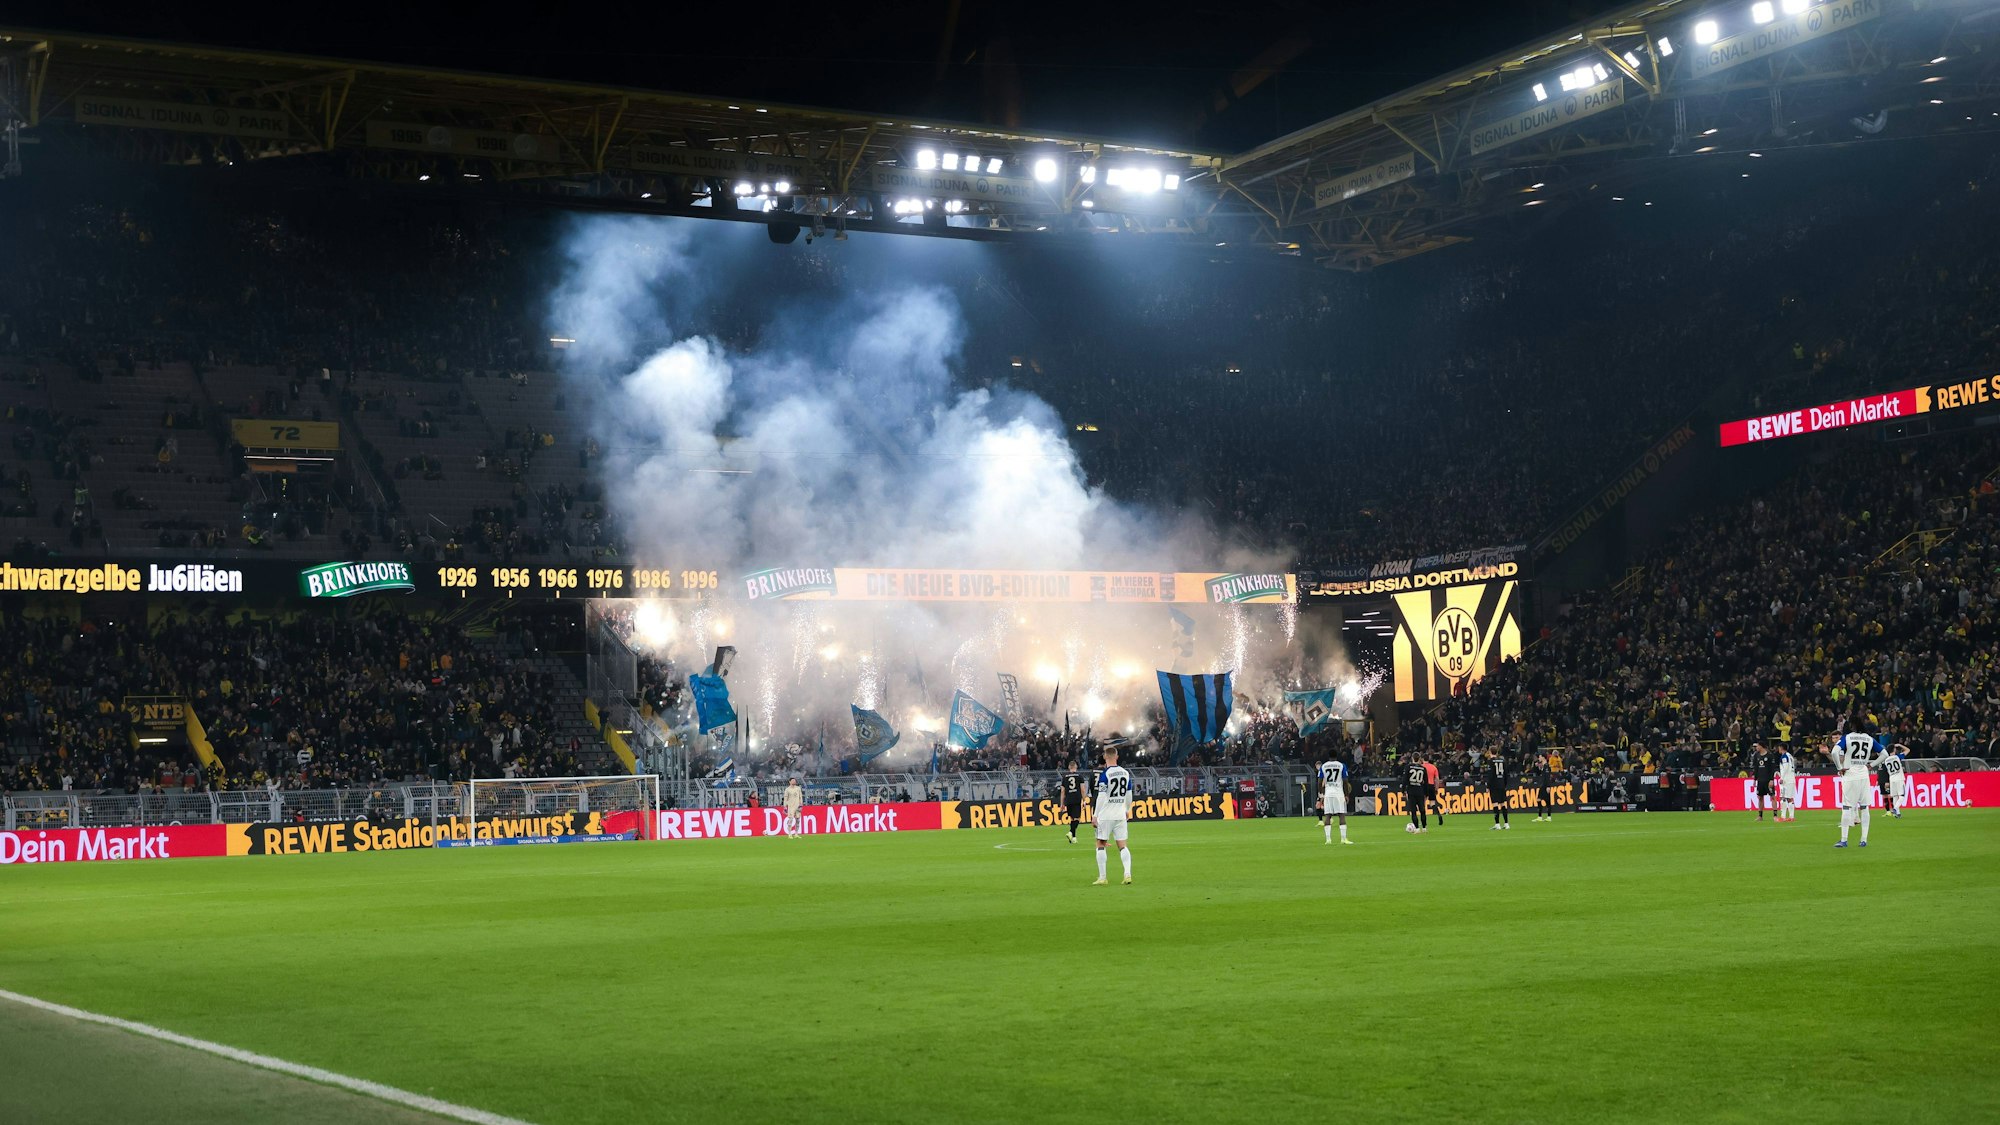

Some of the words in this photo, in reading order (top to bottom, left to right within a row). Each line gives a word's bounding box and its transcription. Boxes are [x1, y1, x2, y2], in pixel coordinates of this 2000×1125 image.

[1696, 44, 1749, 71] SIGNAL
[1753, 23, 1799, 50] IDUNA
[1832, 0, 1876, 24] PARK
[81, 102, 145, 120] SIGNAL
[151, 107, 204, 125] IDUNA
[239, 115, 283, 132] PARK
[1474, 122, 1517, 148] SIGNAL
[1520, 107, 1559, 132] IDUNA
[1584, 85, 1620, 109] PARK
[636, 151, 689, 167] SIGNAL
[693, 154, 737, 170] IDUNA
[766, 162, 804, 177] PARK
[1348, 173, 1373, 188] IDUNA
[1388, 160, 1412, 176] PARK
[877, 173, 927, 190] SIGNAL
[929, 177, 970, 193] IDUNA
[996, 183, 1031, 198] PARK
[1936, 378, 1990, 411] REWE
[1747, 411, 1804, 442] REWE
[1809, 404, 1845, 431] Dein
[1850, 395, 1901, 424] Markt
[270, 426, 300, 440] 72
[1552, 505, 1605, 554] SIGNAL
[1601, 468, 1647, 510] IDUNA
[1657, 421, 1697, 461] PARK
[0, 562, 141, 594] hwarzgelbe
[438, 567, 477, 587] 1926
[491, 567, 530, 587] 1956
[538, 568, 577, 588] 1966
[586, 569, 624, 588] 1976
[632, 569, 671, 588] 1986
[681, 570, 718, 589] 1996
[1112, 575, 1122, 587] IM
[1124, 575, 1154, 587] VIERER
[1370, 559, 1413, 578] ALTONA
[1413, 562, 1519, 589] DORTMUND
[866, 572, 897, 596] DIE
[903, 573, 954, 597] NEUE
[959, 574, 1071, 598] BVB-EDITION
[1438, 613, 1474, 657] BVB
[1449, 656, 1463, 671] 09
[143, 704, 185, 719] NTB
[1850, 741, 1869, 760] 25
[1325, 768, 1340, 782] 27
[1409, 768, 1424, 783] 20
[1495, 762, 1504, 775] 14
[1886, 759, 1901, 773] 20
[1068, 776, 1076, 789] 3
[1110, 776, 1127, 797] 28
[1902, 774, 1967, 808] Markt
[661, 808, 752, 839] REWE
[826, 805, 898, 833] Markt
[970, 801, 1035, 829] REWE
[0, 831, 66, 864] Dein
[77, 828, 170, 861] Markt
[264, 823, 348, 855] REWE
